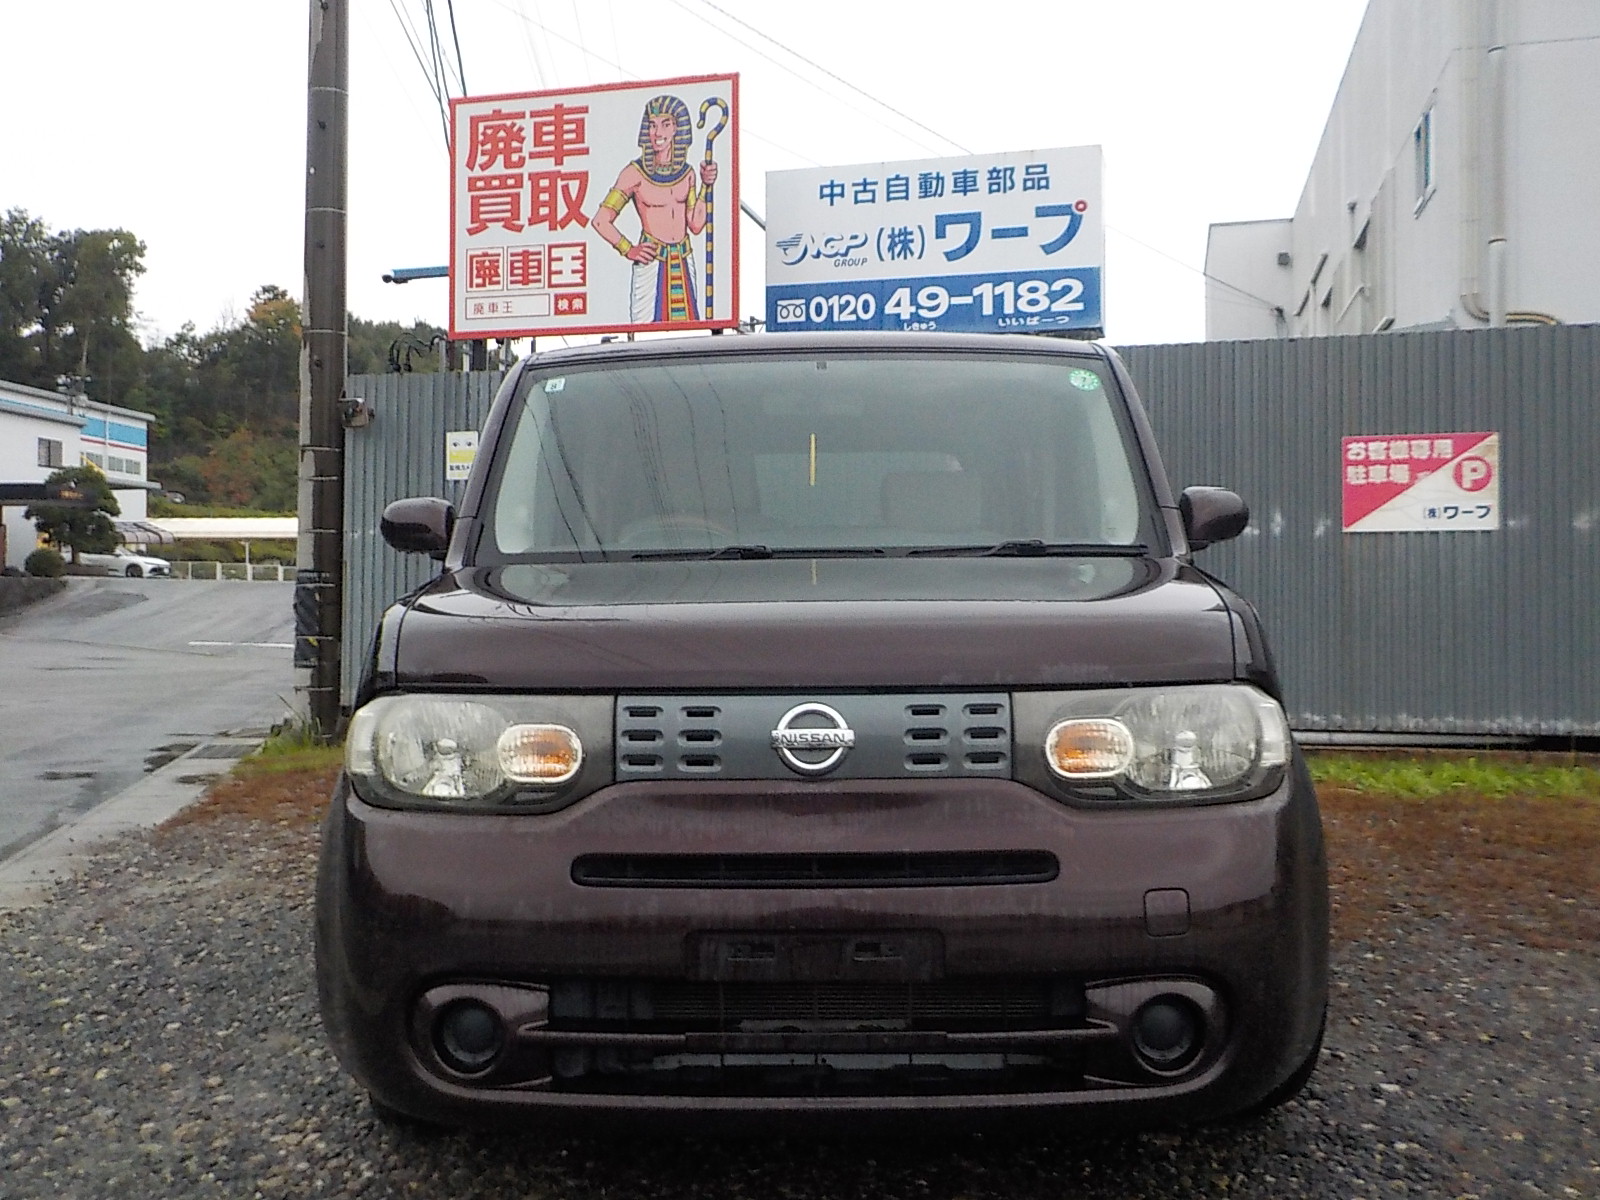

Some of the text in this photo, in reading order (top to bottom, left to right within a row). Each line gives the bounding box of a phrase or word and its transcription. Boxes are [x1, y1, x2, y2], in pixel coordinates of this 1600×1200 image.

[465, 103, 590, 171] 廃車
[466, 170, 590, 236] 買取
[818, 163, 1051, 207] 中古自動車部品
[833, 257, 868, 268] GROUP
[809, 278, 1085, 324] 0120 49-1182
[781, 733, 845, 743] NISSAN
